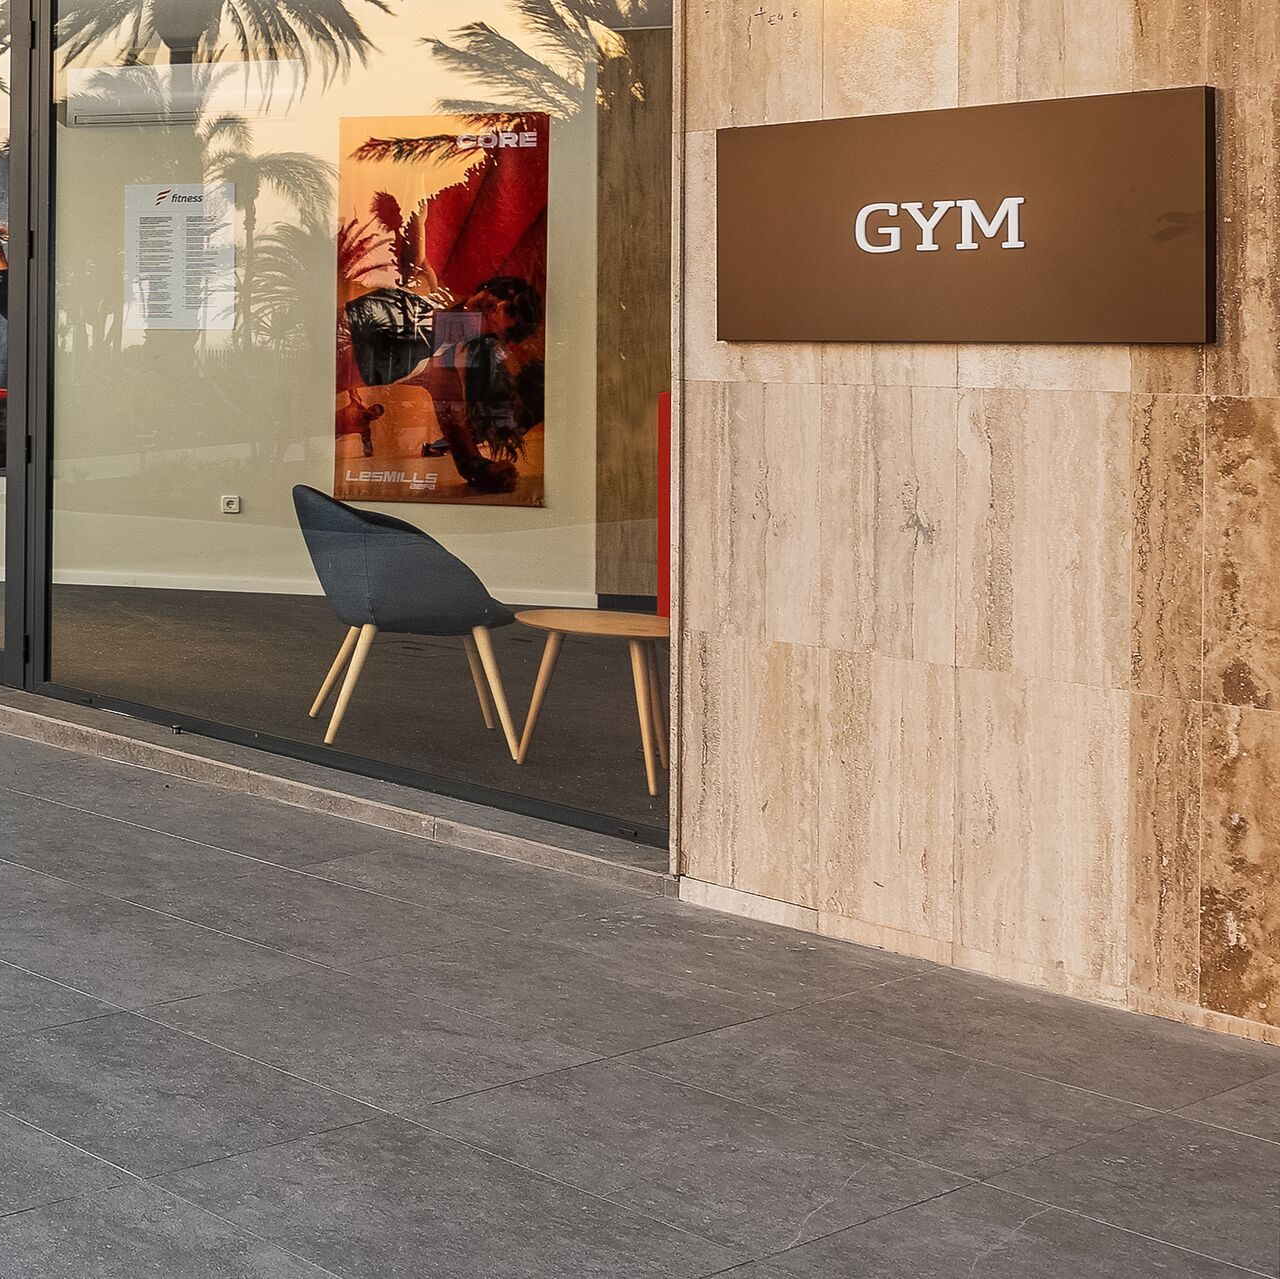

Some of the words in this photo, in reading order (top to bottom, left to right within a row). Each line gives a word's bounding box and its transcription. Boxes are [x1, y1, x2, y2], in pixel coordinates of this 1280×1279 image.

[456, 131, 538, 149] CORE
[171, 193, 204, 203] fitness
[854, 196, 1027, 253] GYM
